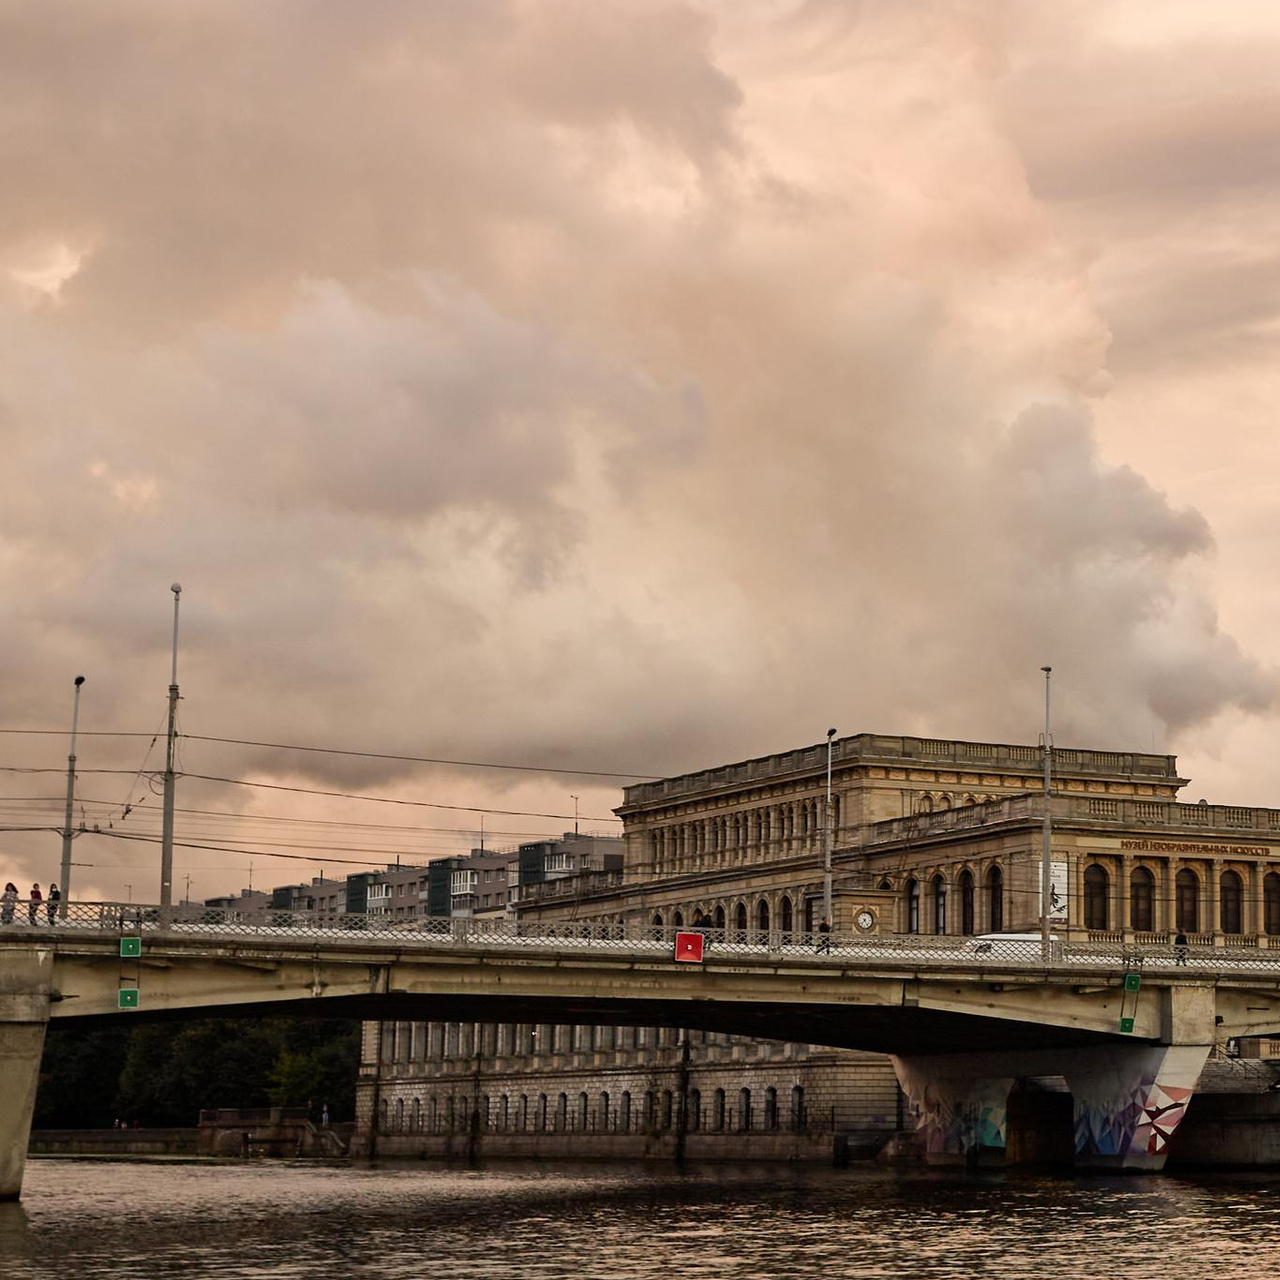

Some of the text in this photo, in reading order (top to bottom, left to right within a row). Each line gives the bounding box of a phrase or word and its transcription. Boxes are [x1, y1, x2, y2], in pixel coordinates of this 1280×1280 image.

[1120, 840, 1271, 856] МУЗЕЙ ИЗОБРАЗИТЕЛЬНЫХ ИСКУССТВ
